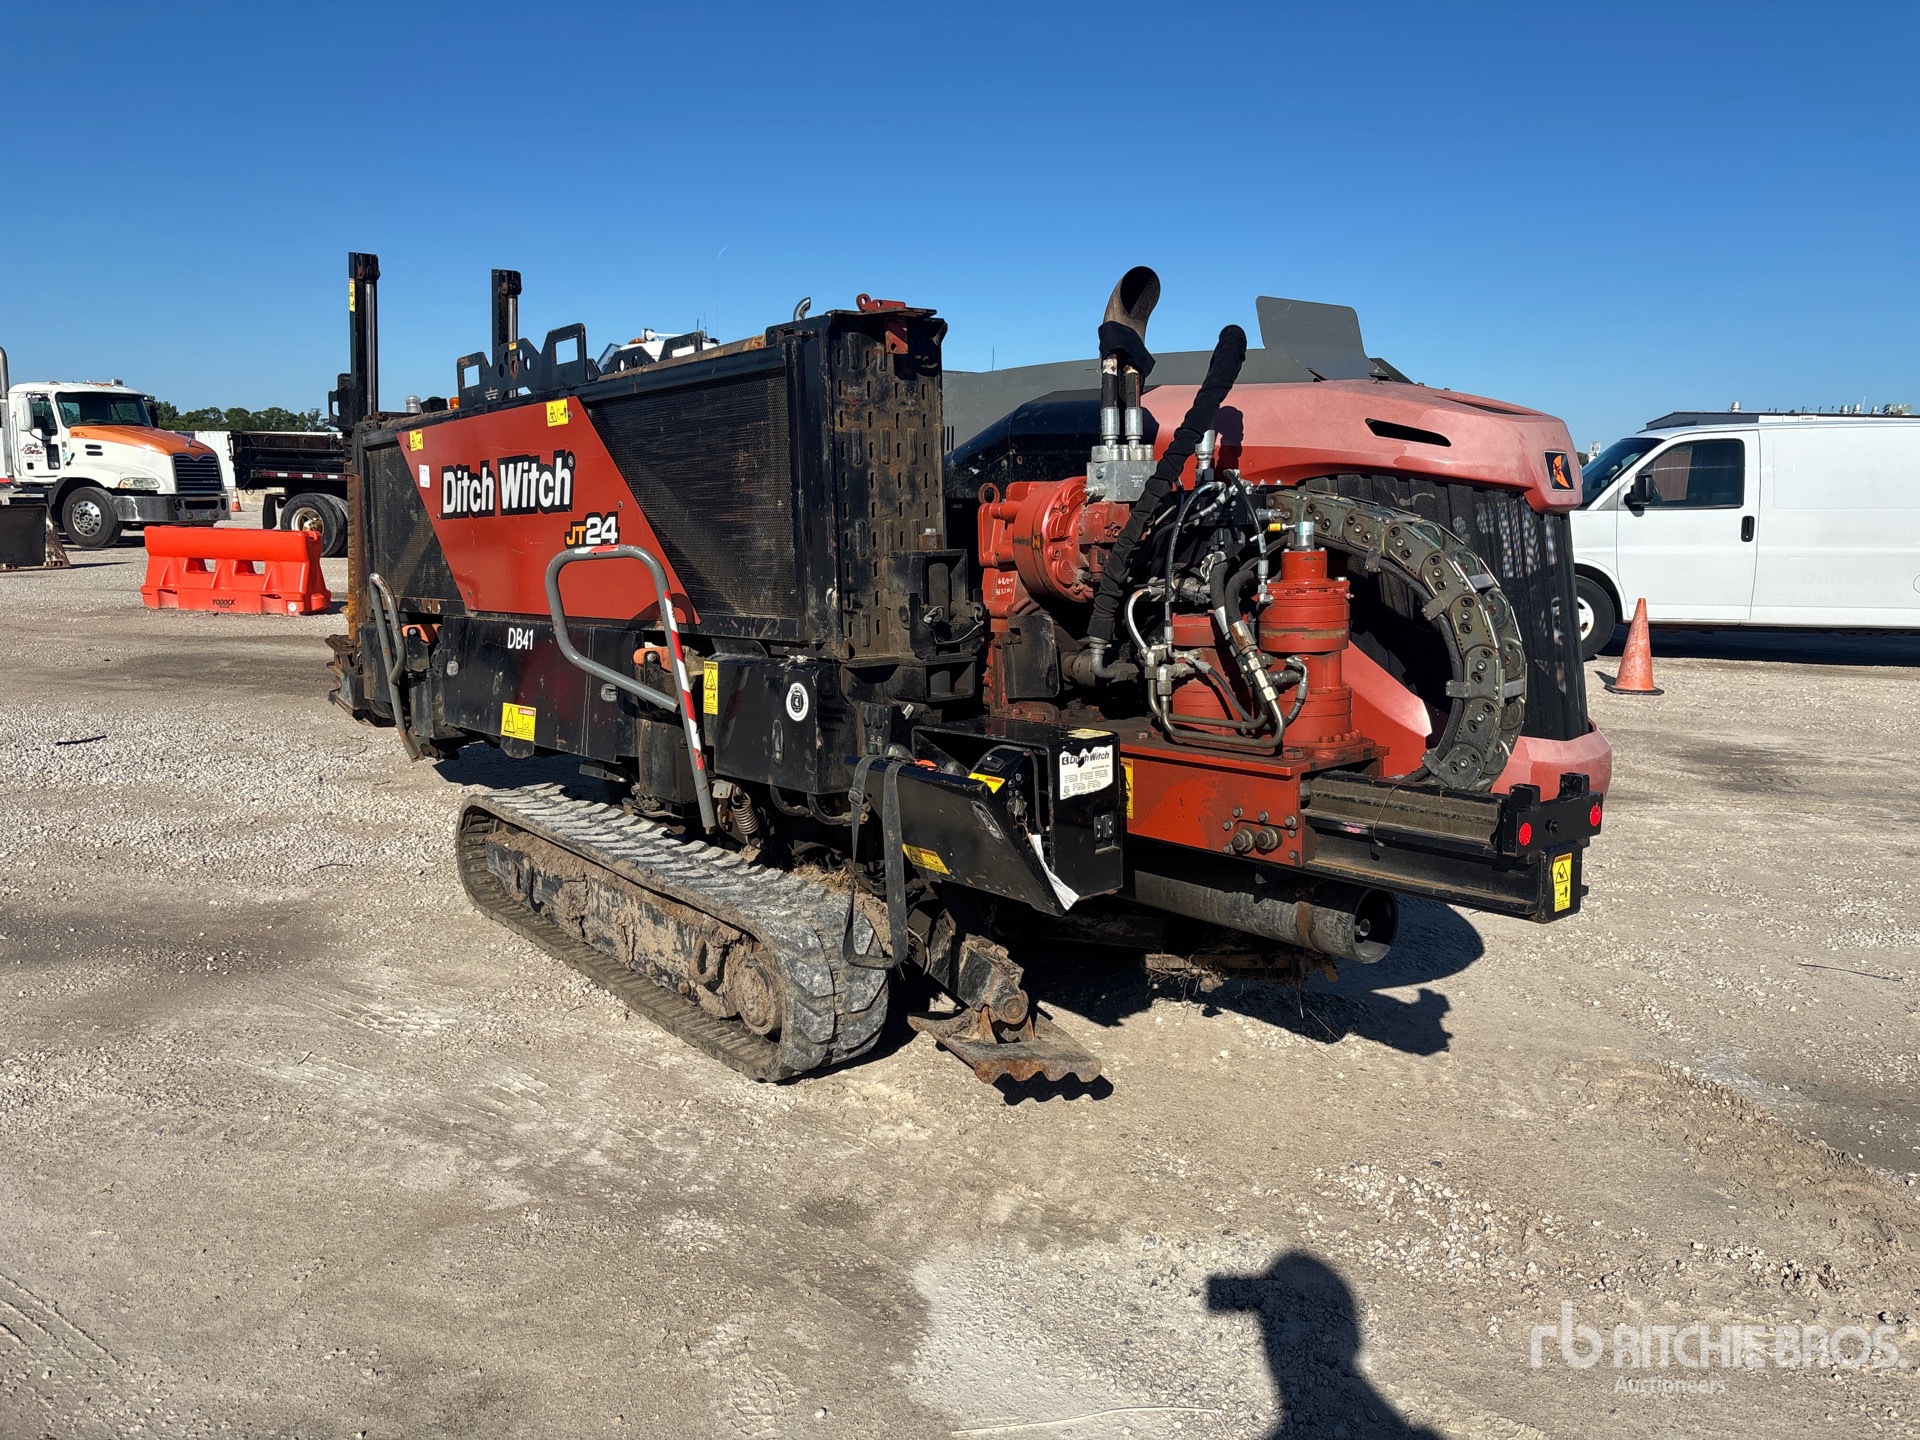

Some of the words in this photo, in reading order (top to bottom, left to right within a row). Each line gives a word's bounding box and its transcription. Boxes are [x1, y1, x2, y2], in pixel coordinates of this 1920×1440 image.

[442, 466, 495, 514] Ditch
[500, 457, 571, 509] Witch
[566, 516, 618, 545] JT24
[507, 627, 534, 650] DB41
[1090, 751, 1109, 761] Witch
